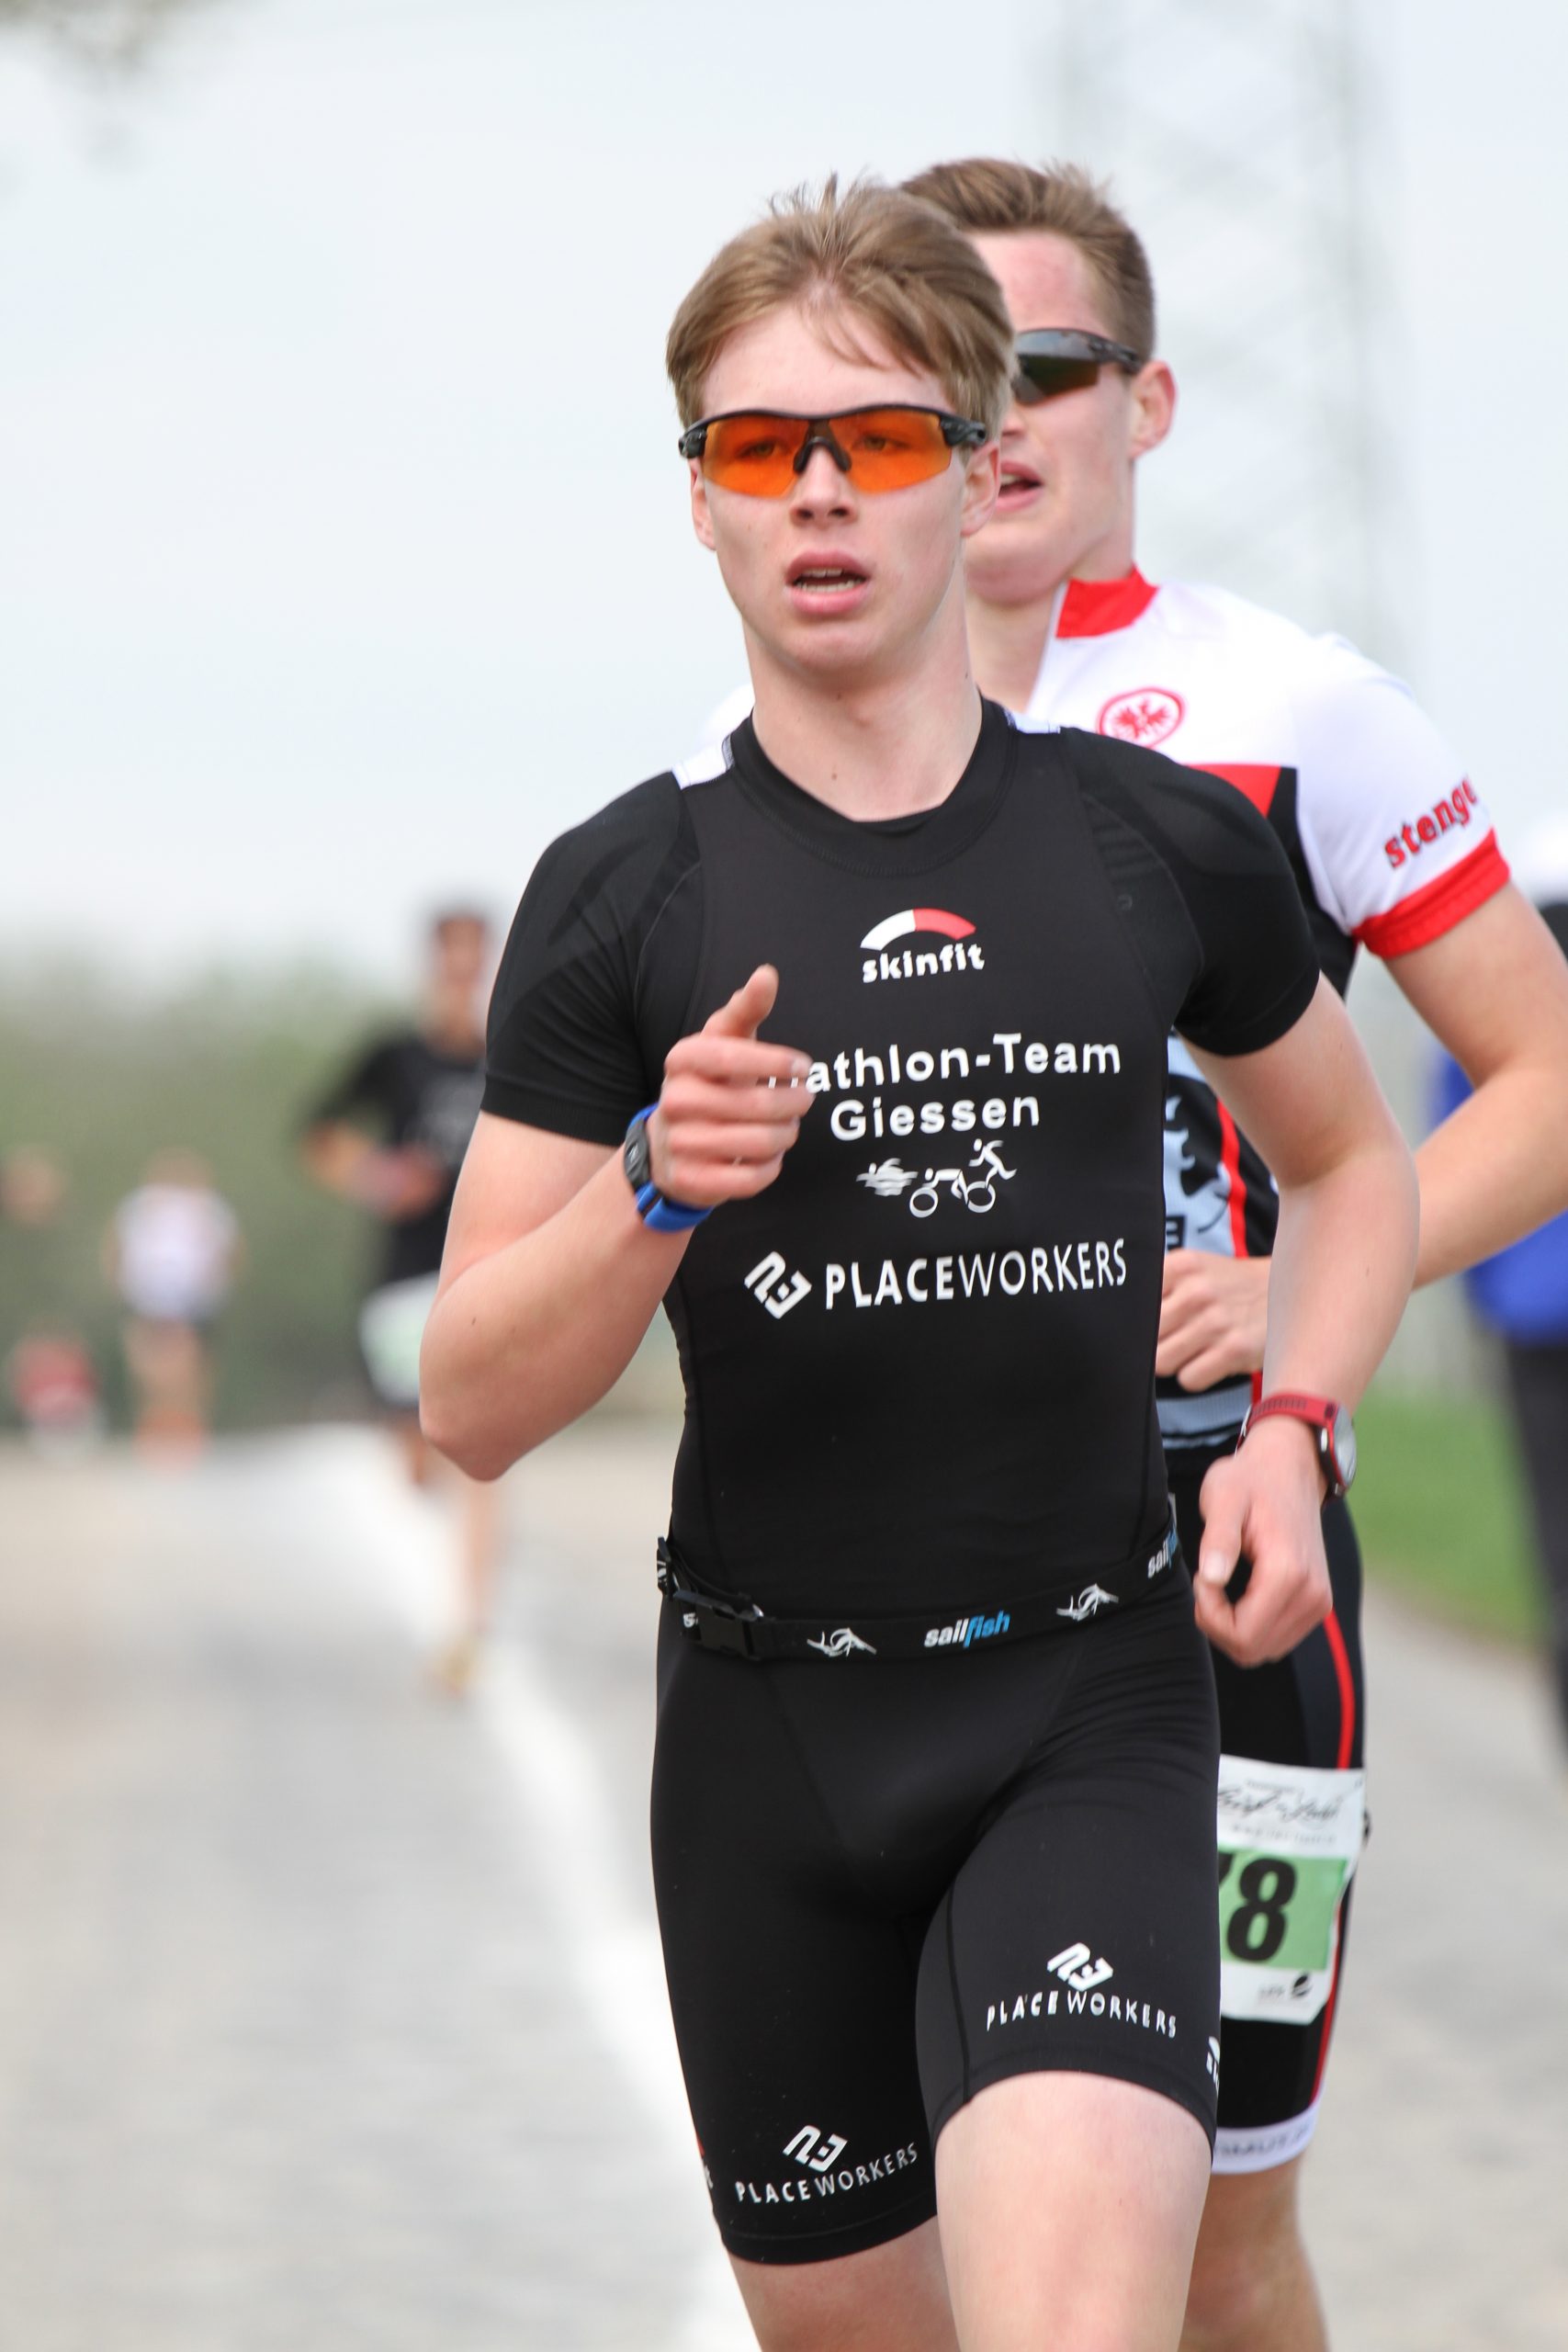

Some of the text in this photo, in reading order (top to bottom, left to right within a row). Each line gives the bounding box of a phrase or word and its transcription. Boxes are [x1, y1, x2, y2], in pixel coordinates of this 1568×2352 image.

[862, 943, 985, 983] skinfit
[768, 1033, 1122, 1093] athlon-Team
[830, 1096, 1040, 1141] Giessen
[826, 1238, 1127, 1310] PLACEWORKERS
[923, 1610, 1010, 1648] sailfish
[1218, 1851, 1297, 1962] 8
[735, 2142, 918, 2204] PLACEWORKERS
